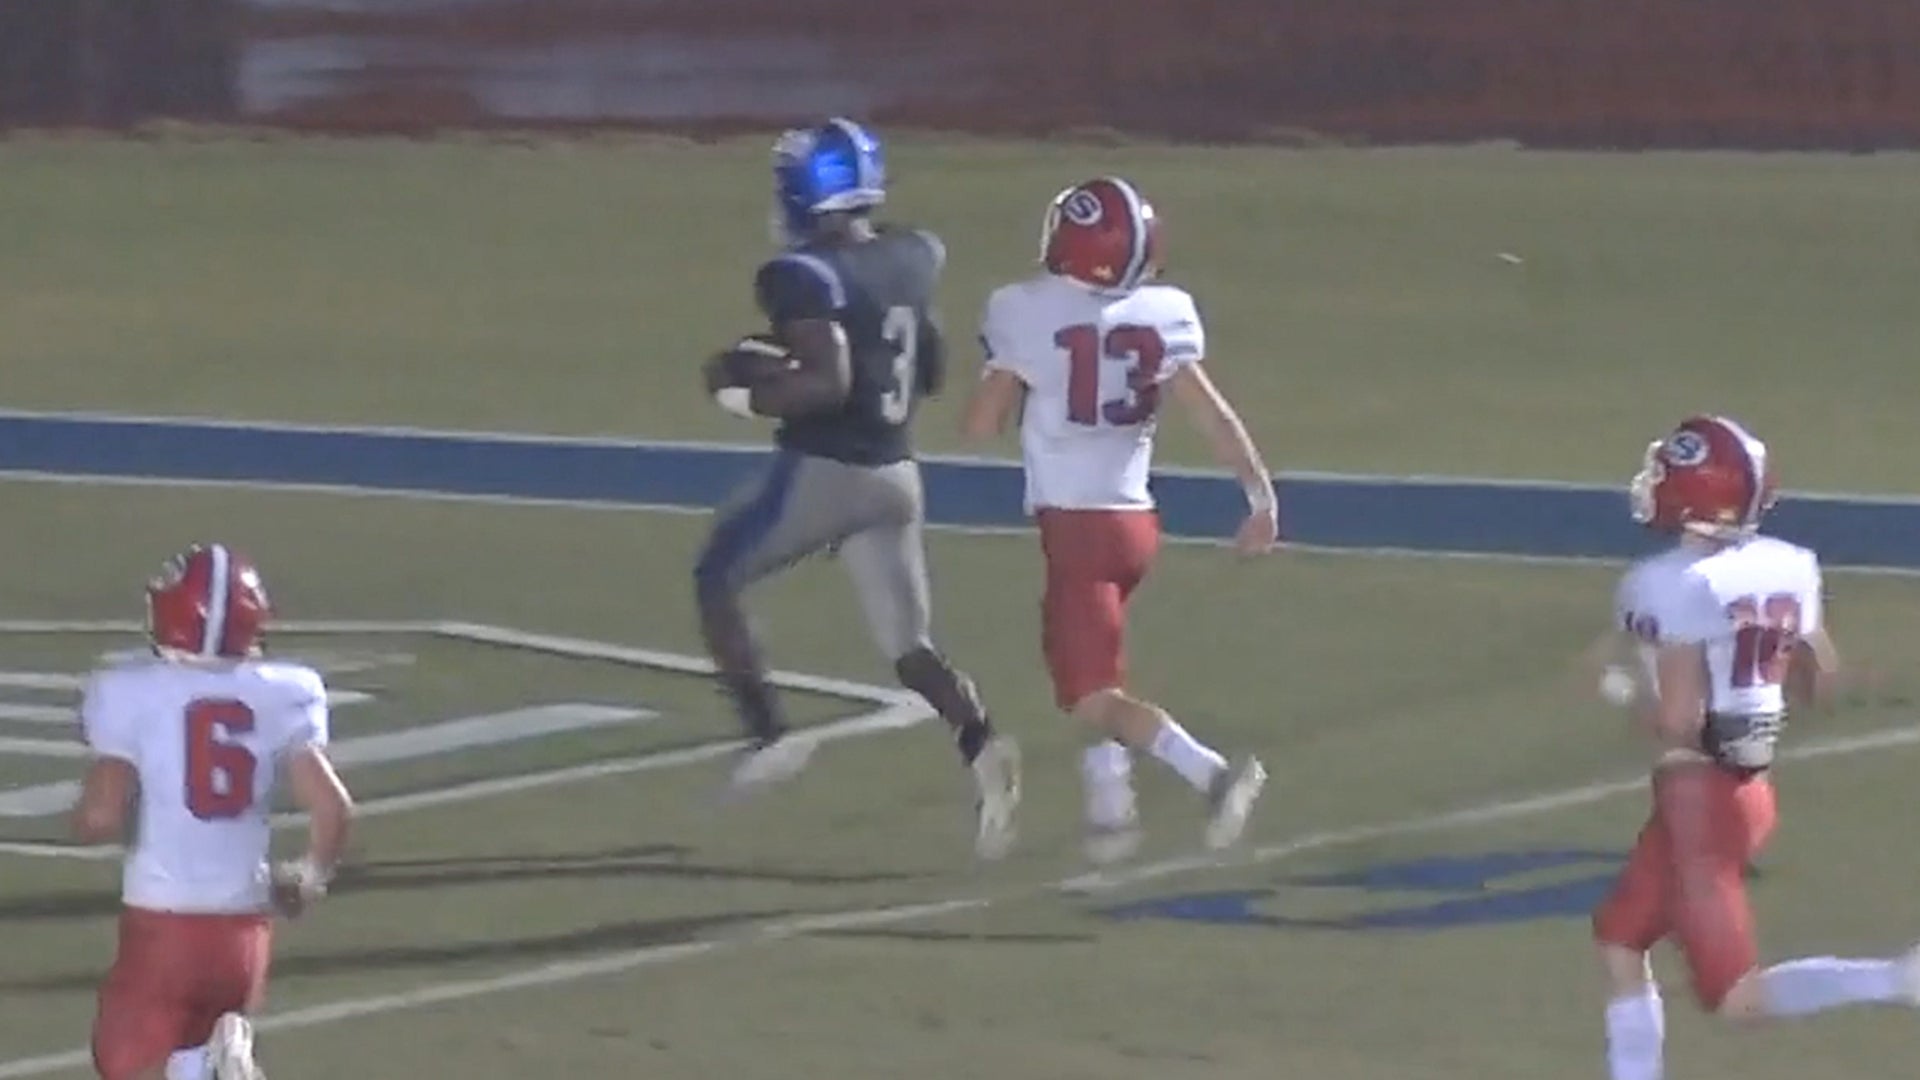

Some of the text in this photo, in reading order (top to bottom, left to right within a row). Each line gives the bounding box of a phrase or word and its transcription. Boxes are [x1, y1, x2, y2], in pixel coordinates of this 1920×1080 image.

[881, 306, 917, 424] 3
[1055, 324, 1165, 426] 13
[185, 699, 257, 819] 6
